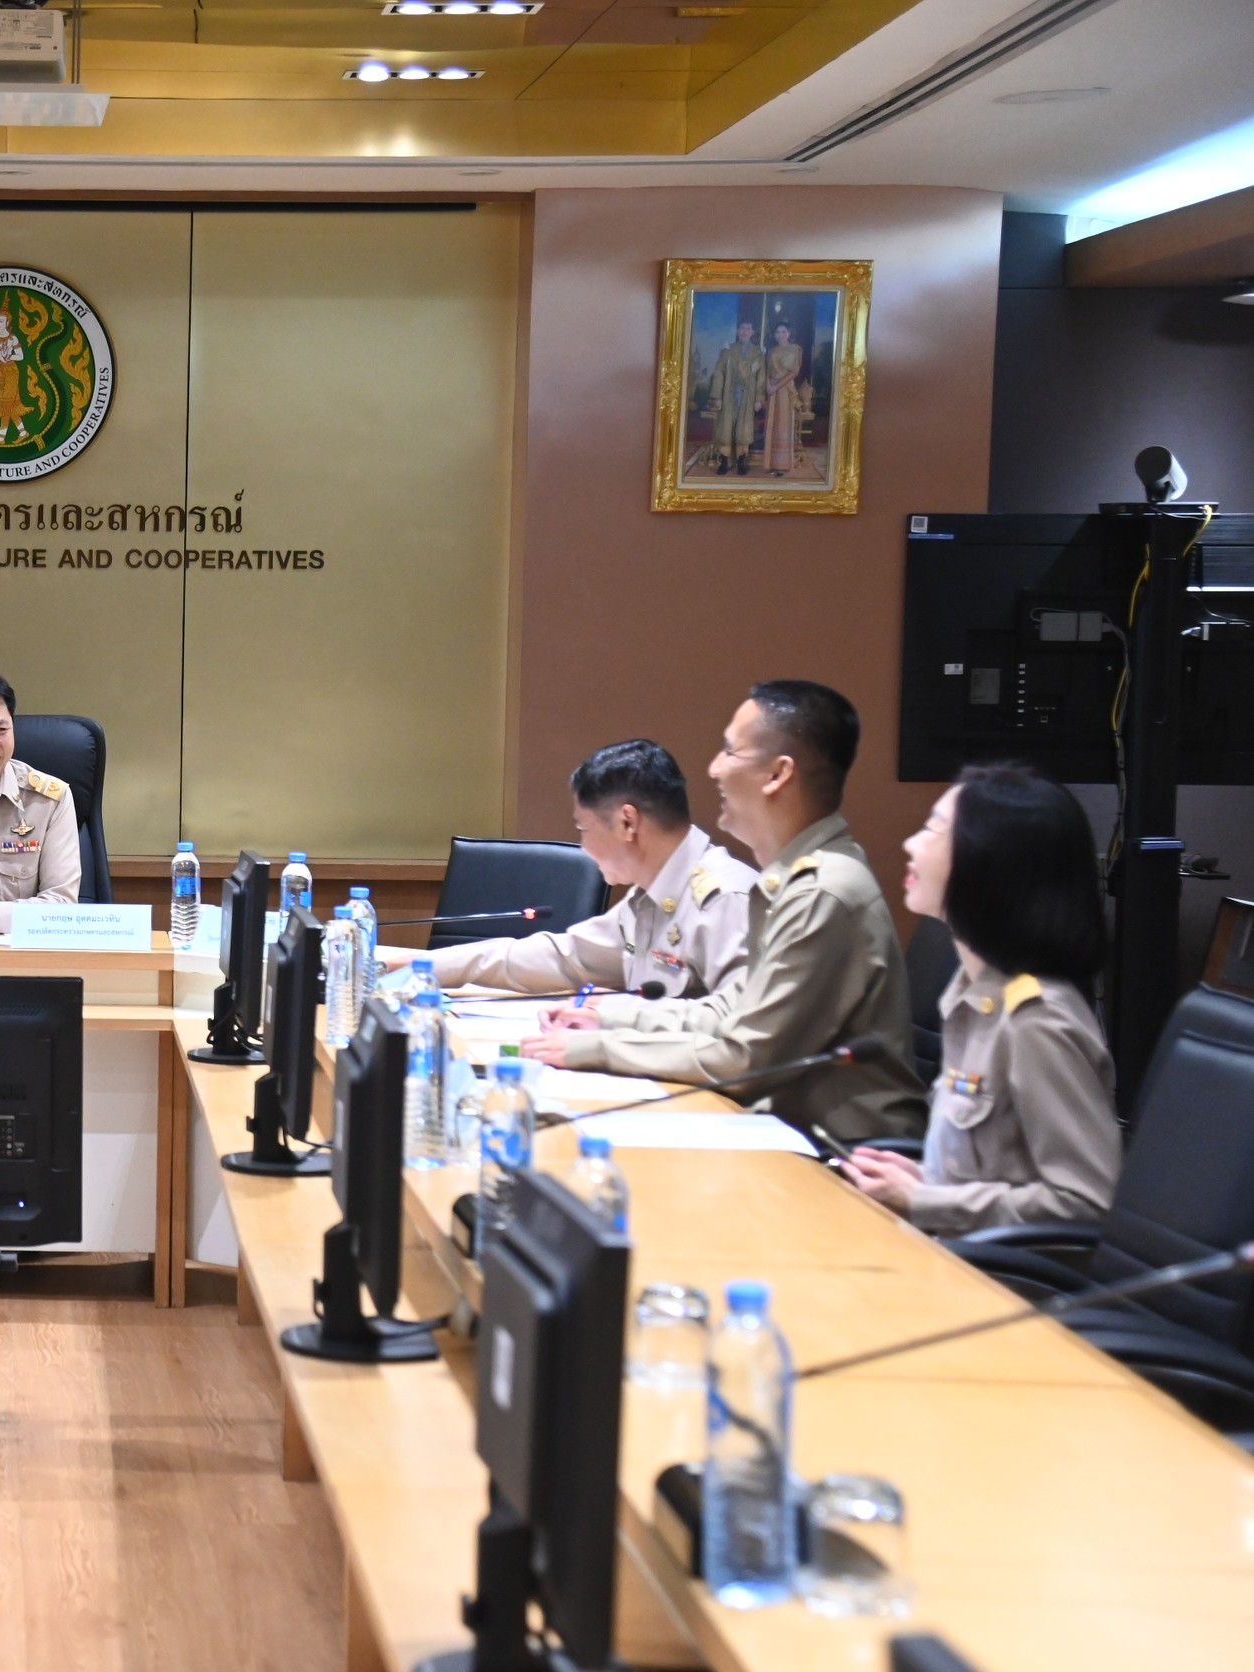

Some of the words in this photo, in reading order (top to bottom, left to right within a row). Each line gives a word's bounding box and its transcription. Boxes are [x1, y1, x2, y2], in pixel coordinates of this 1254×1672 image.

[35, 454, 61, 473] AND
[61, 366, 110, 458] COOPERATIVES
[57, 548, 114, 569] AND
[124, 548, 326, 571] COOPERATIVES
